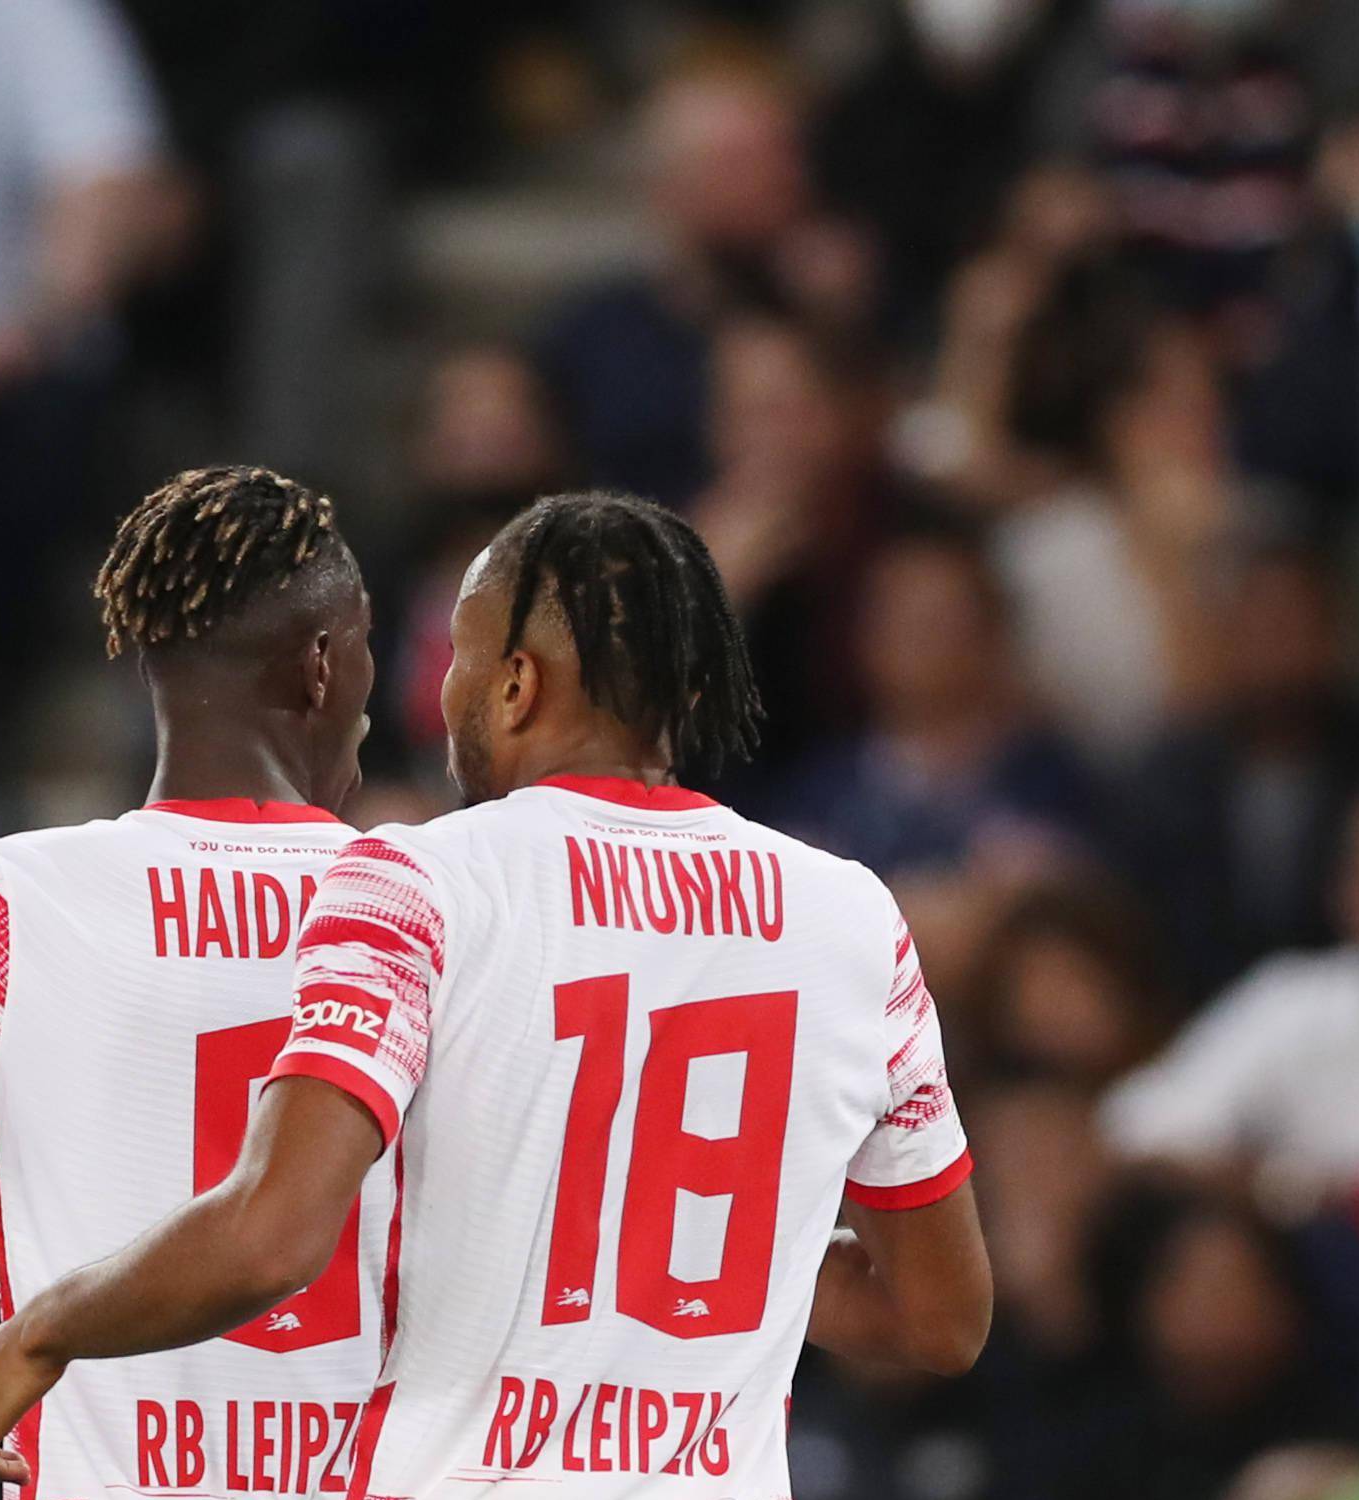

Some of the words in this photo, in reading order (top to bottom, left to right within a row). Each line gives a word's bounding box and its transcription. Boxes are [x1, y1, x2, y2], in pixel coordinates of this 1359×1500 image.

[189, 841, 219, 852] YOU
[224, 844, 253, 853] CAN
[608, 827, 636, 835] CAN
[662, 832, 727, 842] ANYTHING
[564, 835, 784, 942] NKUNKU
[541, 973, 799, 1340] 18
[137, 1399, 206, 1487] RB
[482, 1376, 559, 1470] RB
[562, 1383, 730, 1477] LEIPZIG
